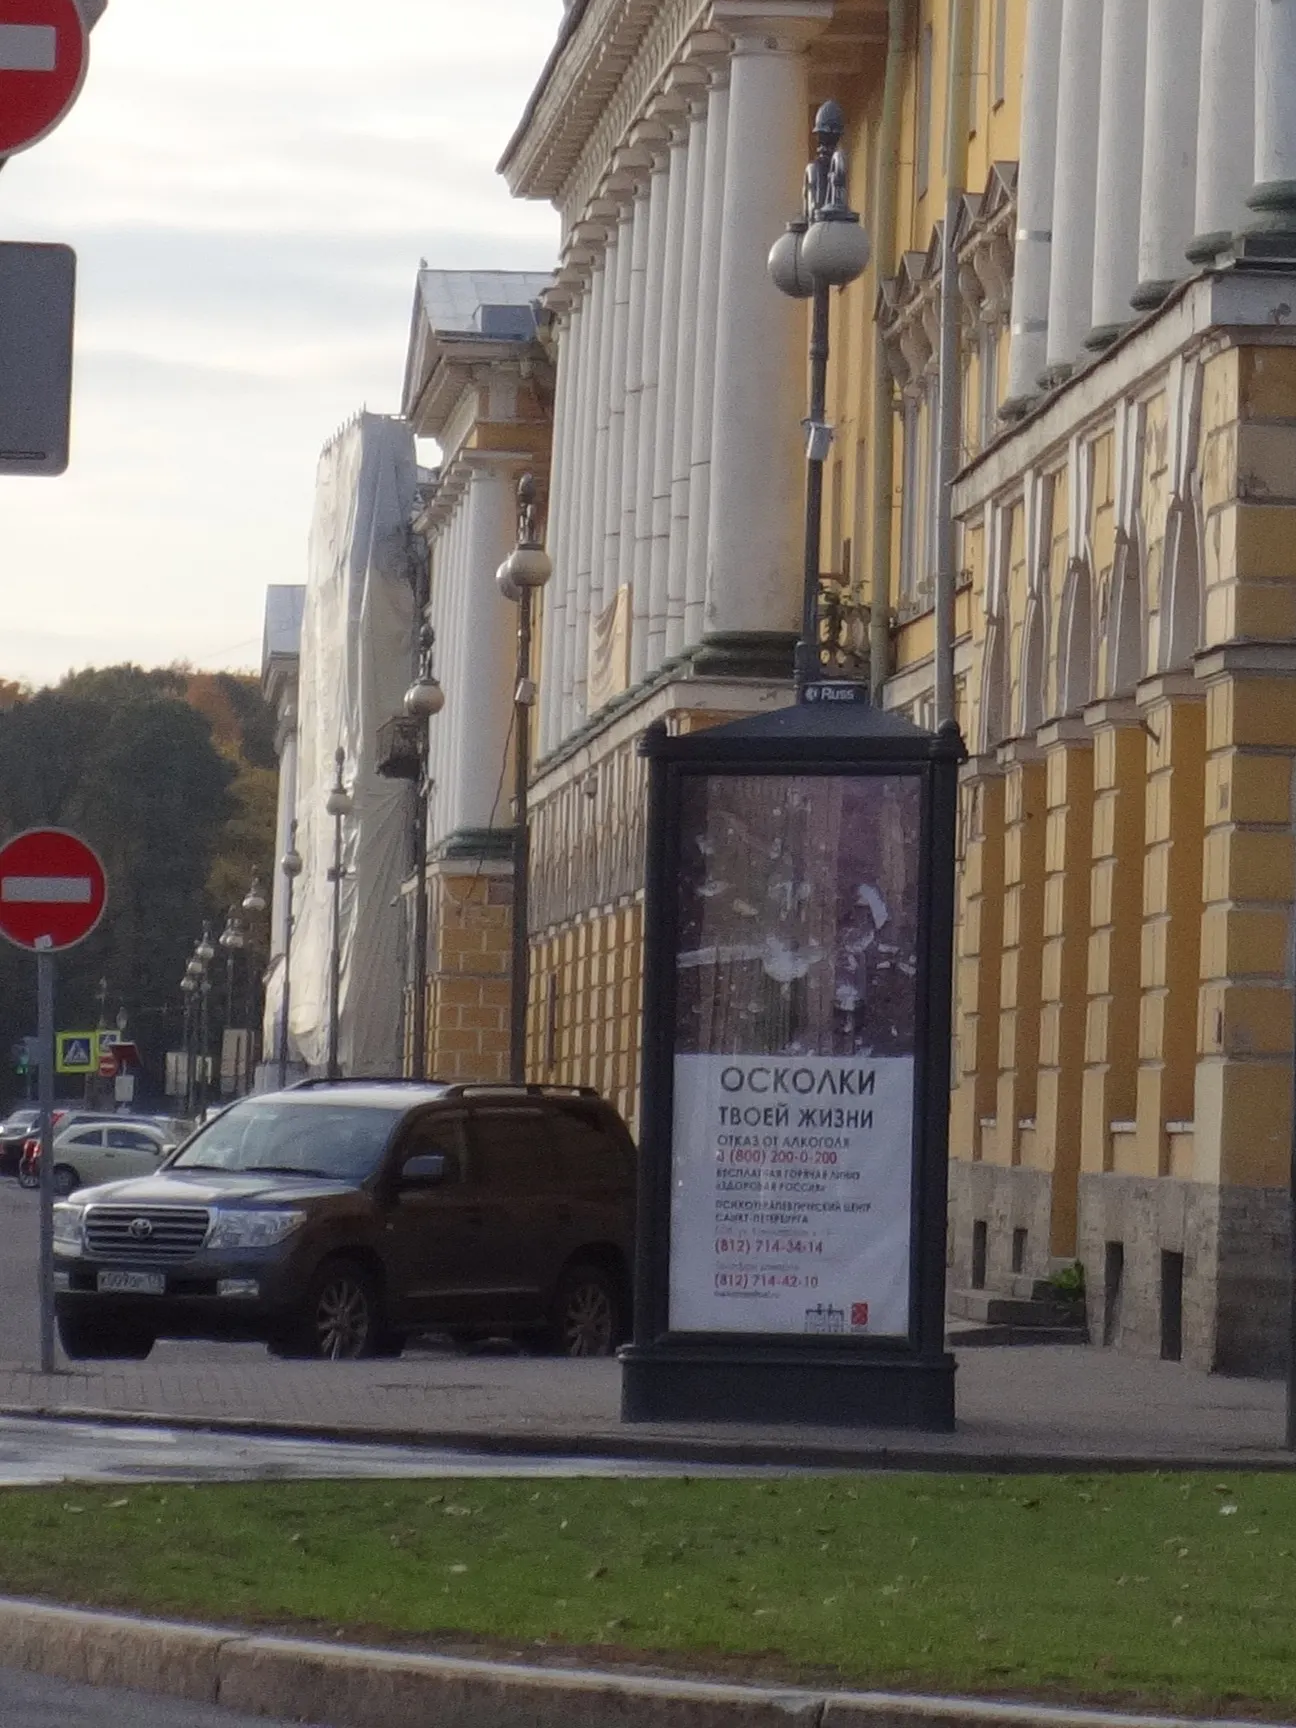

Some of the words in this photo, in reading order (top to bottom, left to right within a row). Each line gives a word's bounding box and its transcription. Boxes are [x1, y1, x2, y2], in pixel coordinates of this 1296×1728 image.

[821, 686, 855, 700] Russ
[720, 1066, 876, 1095] ОСКОЛКИ
[718, 1102, 789, 1127] ТВОЕЙ
[797, 1107, 874, 1129] ЖИЗНИ
[717, 1135, 760, 1148] ОТКАЗ
[763, 1136, 779, 1148] ОТ
[783, 1136, 851, 1149] АЛКОГОЛЯ
[730, 1150, 766, 1165] (800)
[770, 1151, 838, 1165] 200-0-200
[714, 1239, 751, 1255] (812)
[756, 1240, 823, 1255] 714-34-14
[714, 1272, 749, 1289] (812)
[752, 1274, 819, 1288] 714-42-10
